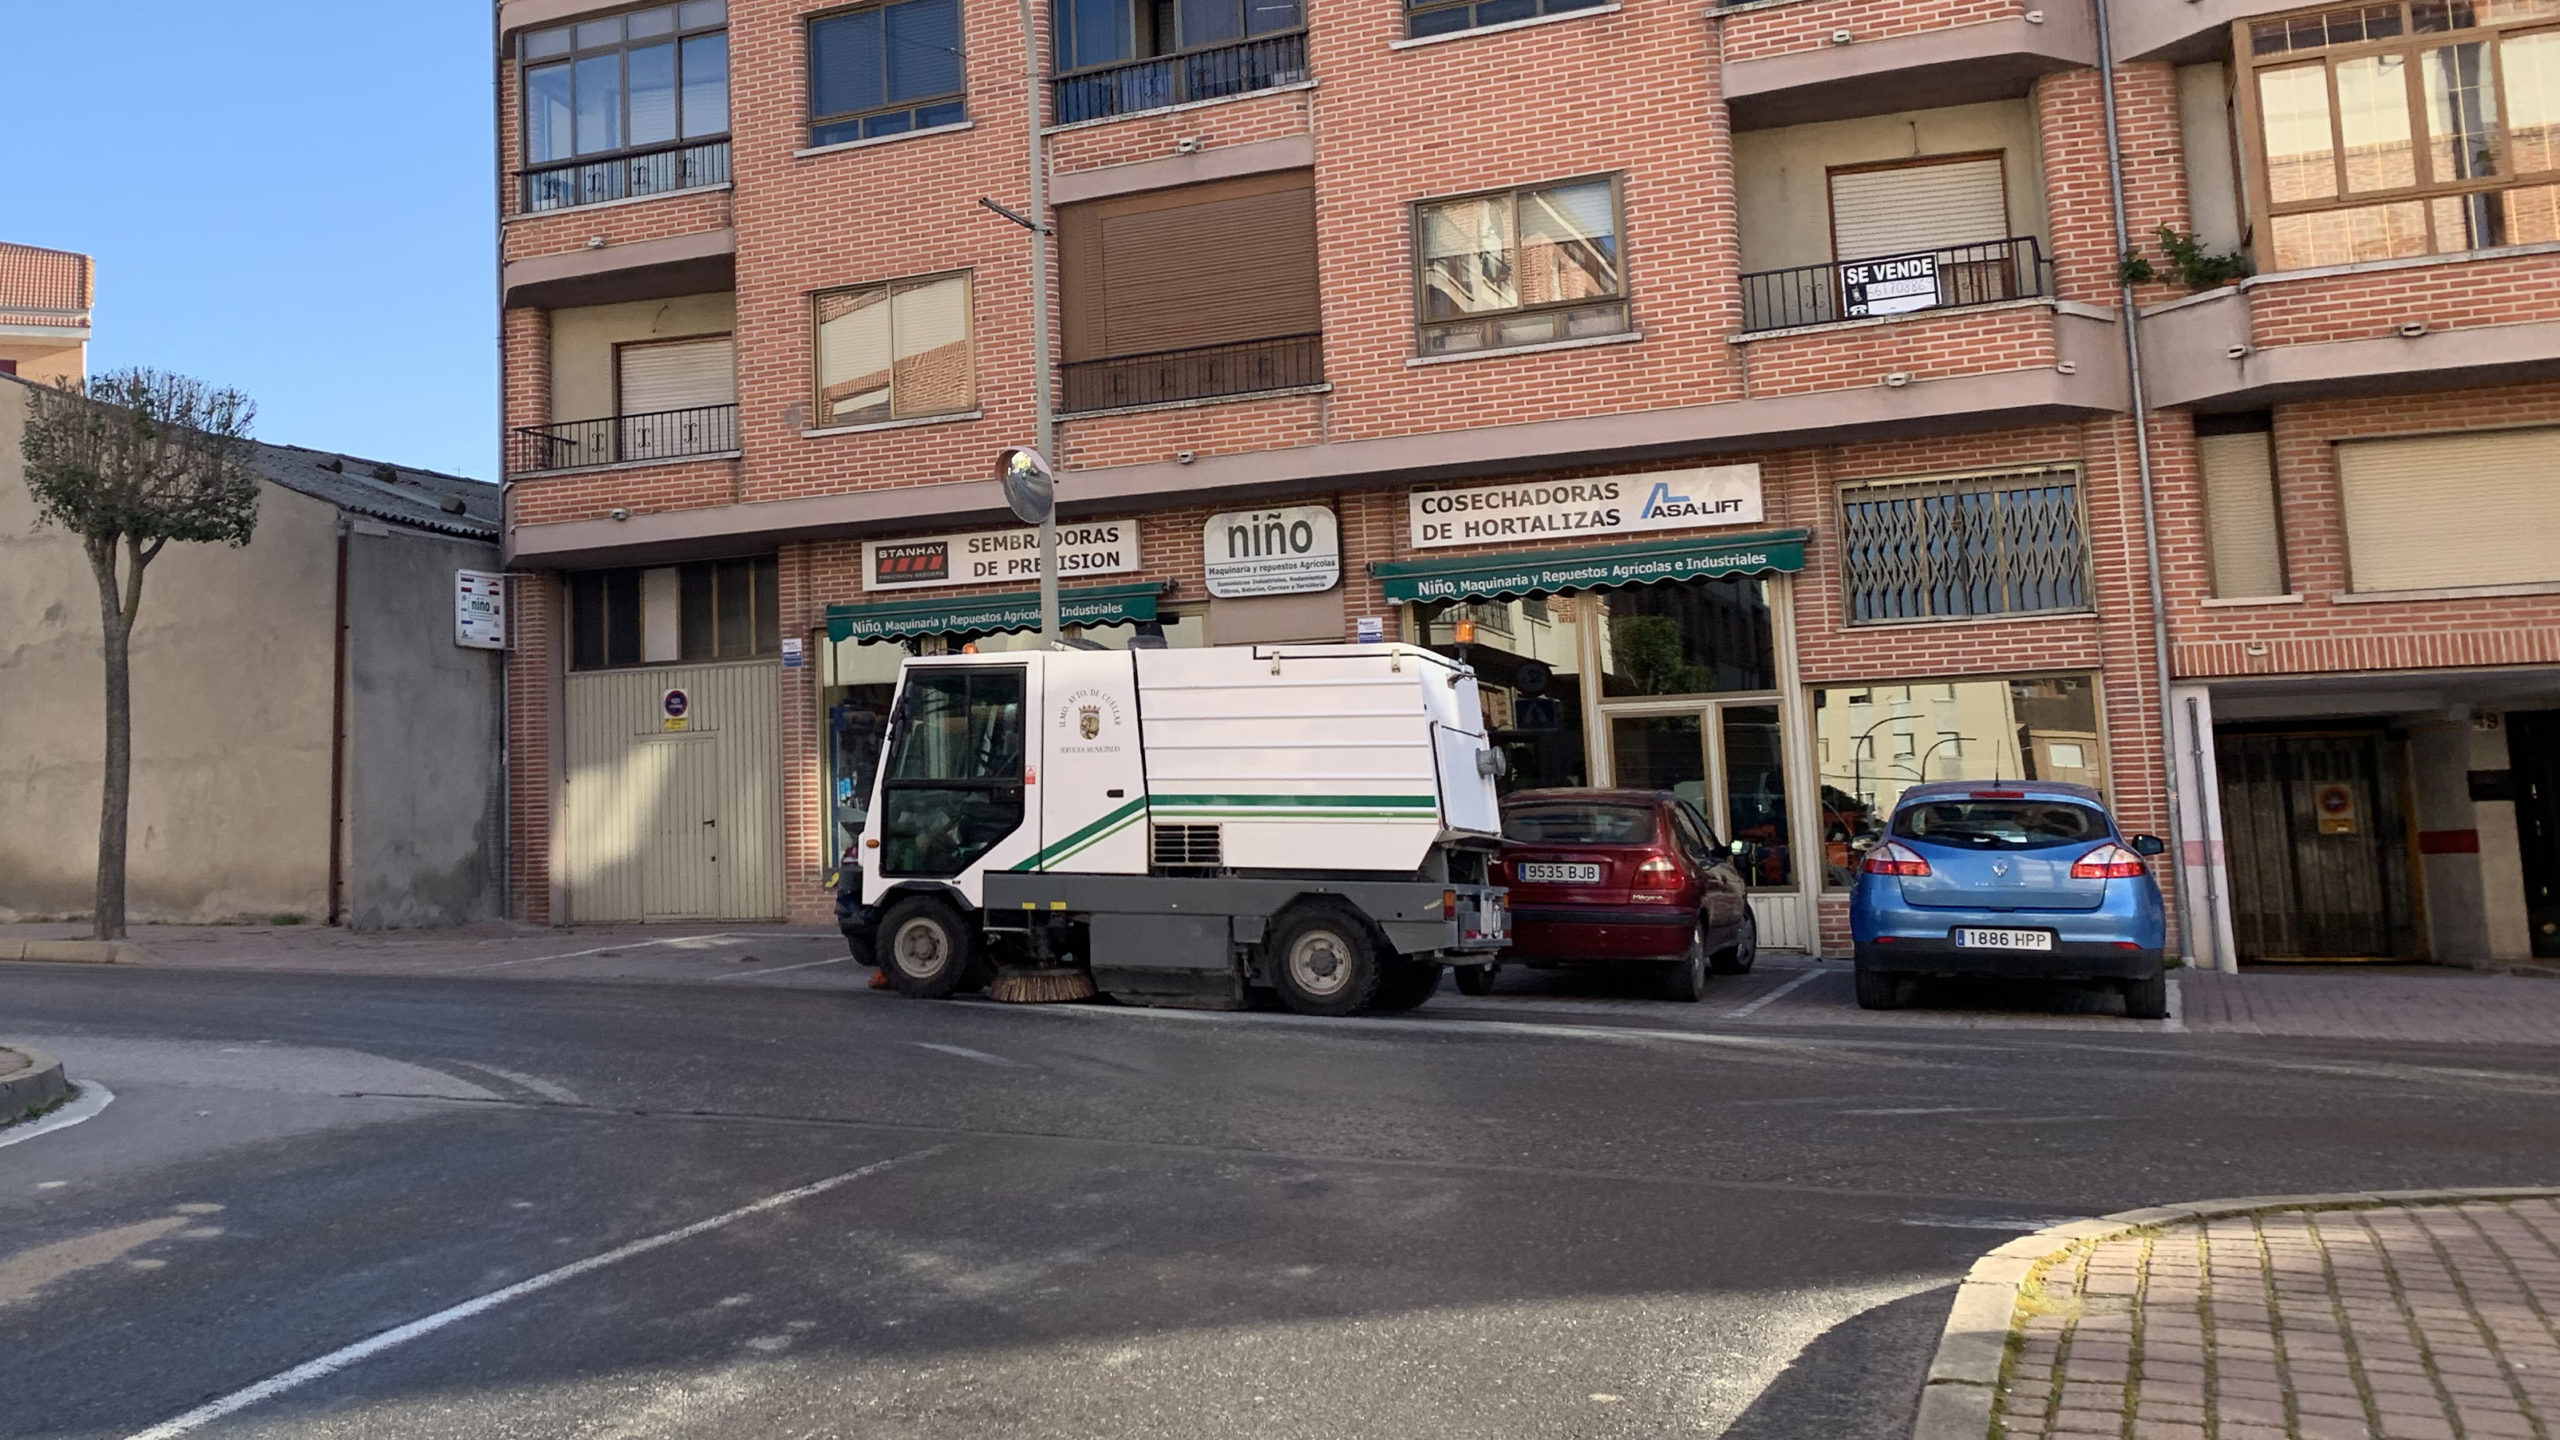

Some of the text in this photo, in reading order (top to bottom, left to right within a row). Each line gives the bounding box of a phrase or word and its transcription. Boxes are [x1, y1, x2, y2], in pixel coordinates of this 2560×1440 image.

[1847, 258, 1934, 285] SE VENDE
[1421, 482, 1620, 515] COSECHADORAS
[1227, 512, 1313, 558] niño
[1422, 508, 1621, 541] DE HORTALIZAS
[879, 545, 944, 559] STANHAY
[968, 527, 1119, 553] SEMBRDORAS
[974, 551, 1120, 577] DE PREISION
[1209, 565, 1251, 576] Maquinaria
[1253, 565, 1258, 573] y
[1260, 563, 1298, 573] repuestos
[1418, 553, 1767, 596] Niño, Maquinaria y Repuestos Agrícolas e Industriales
[852, 619, 883, 634] Niño,
[885, 617, 939, 632] Maquinaria
[941, 618, 948, 628] y
[950, 612, 1001, 627] Repuestos
[1061, 603, 1123, 617] Industriales
[1528, 865, 1595, 880] 9535 BJB
[1971, 932, 2046, 948] 1886 HPP
